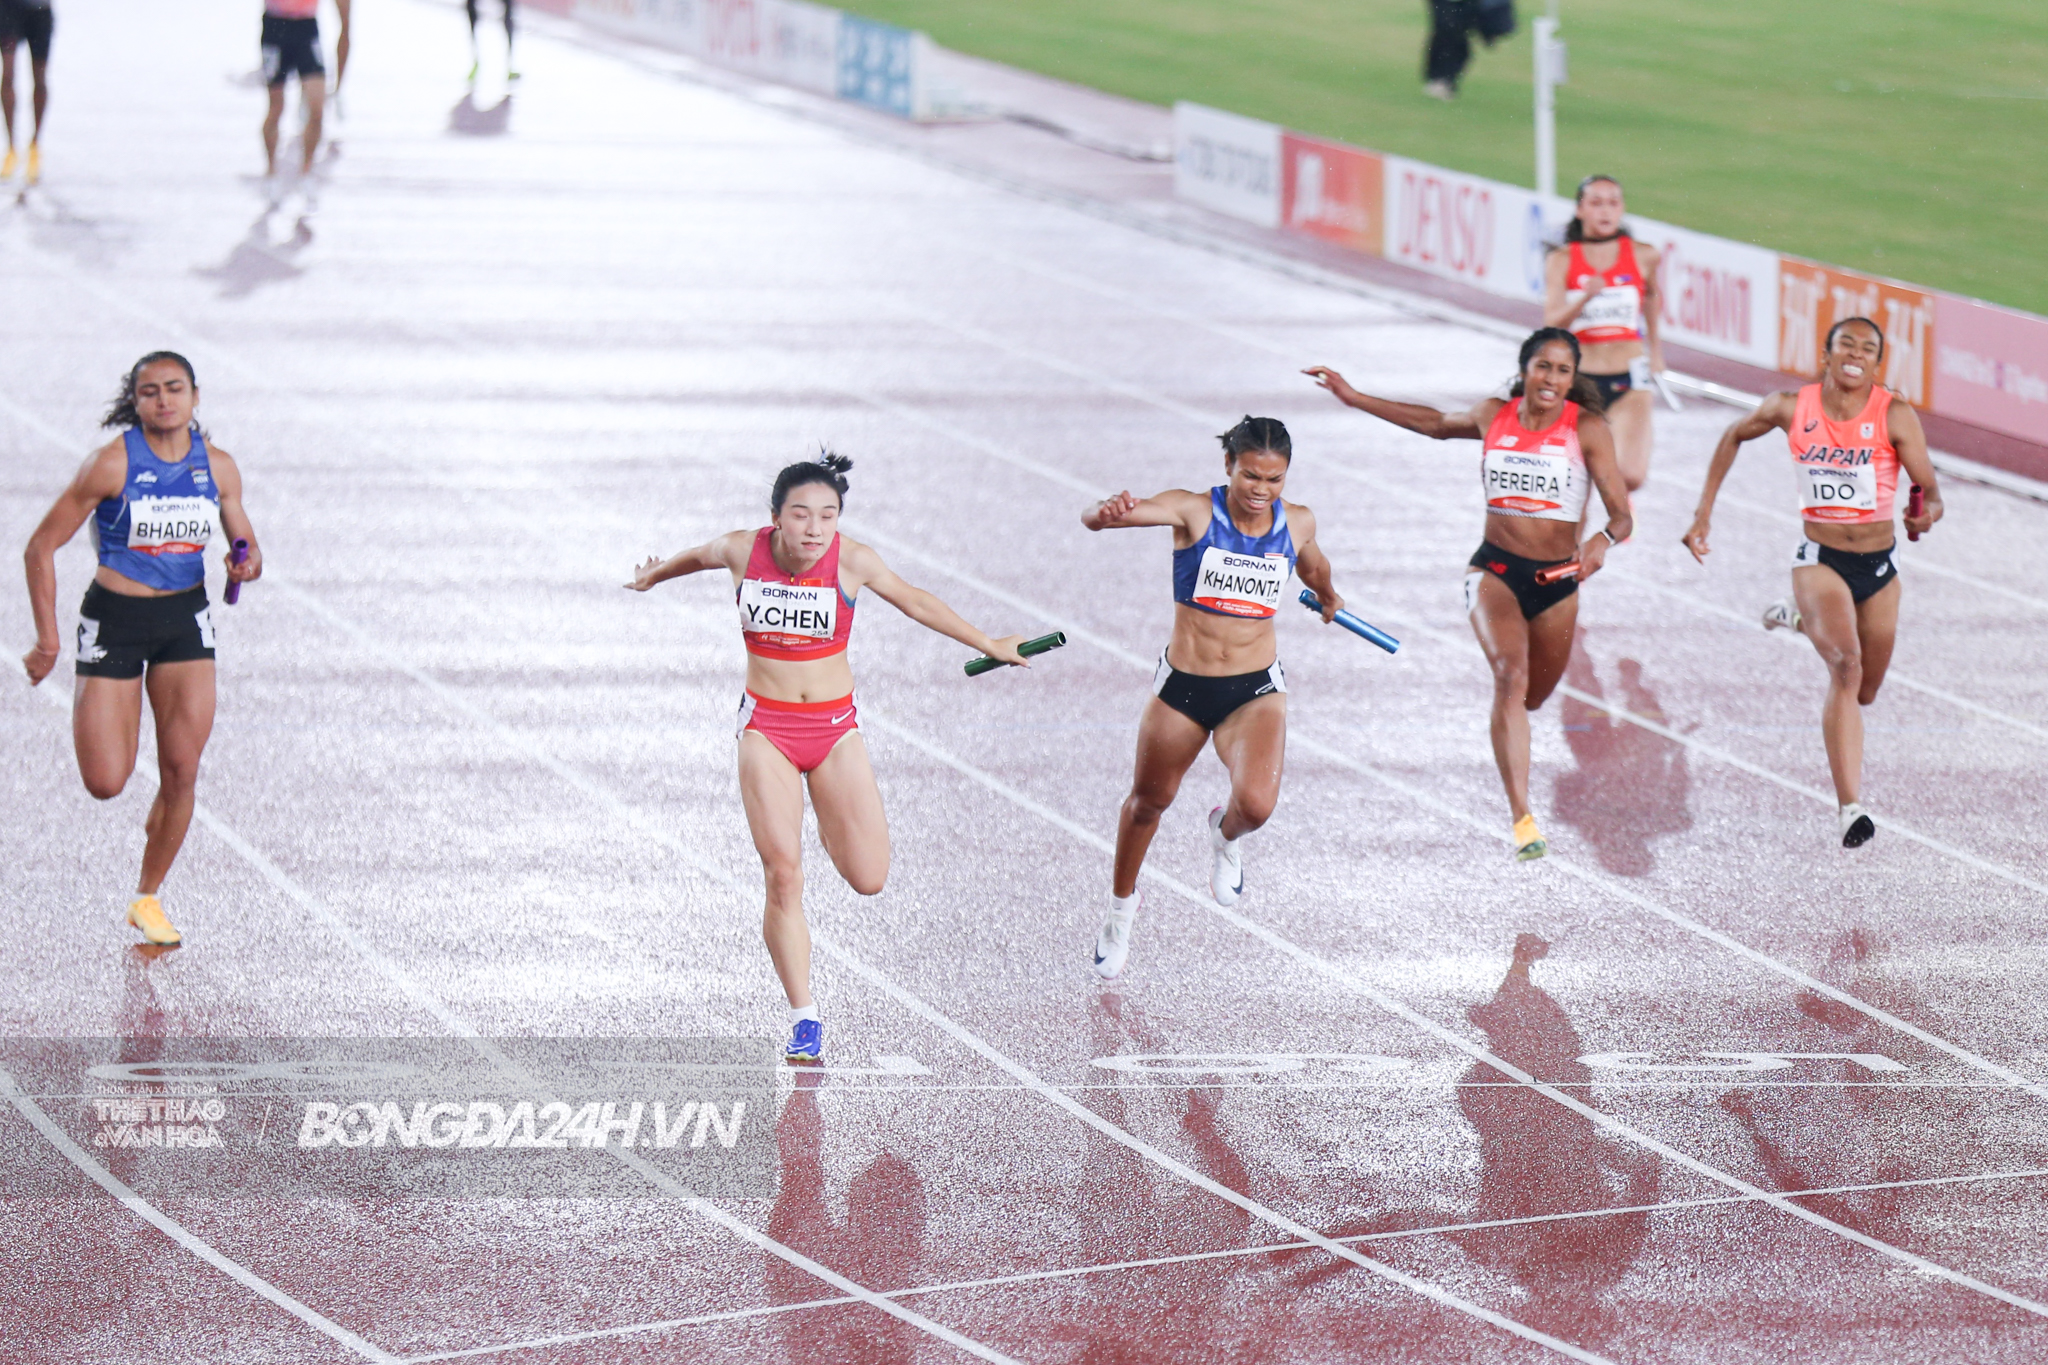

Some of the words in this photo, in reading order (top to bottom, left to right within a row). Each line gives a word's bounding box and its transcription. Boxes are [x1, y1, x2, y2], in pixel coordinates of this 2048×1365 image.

[1398, 170, 1496, 276] DENSO
[1503, 455, 1551, 468] BORNAN
[1799, 444, 1874, 466] JAPAN
[1489, 469, 1560, 494] PEREIRA
[1808, 468, 1858, 478] BORNAN
[1812, 483, 1855, 500] IDO
[151, 503, 200, 514] BORNAN
[137, 519, 211, 539] BHADRA
[1222, 556, 1277, 572] BORNAN
[1203, 569, 1280, 598] KHANONTA
[761, 587, 818, 601] BORNAN
[746, 603, 829, 630] Y.CHEN
